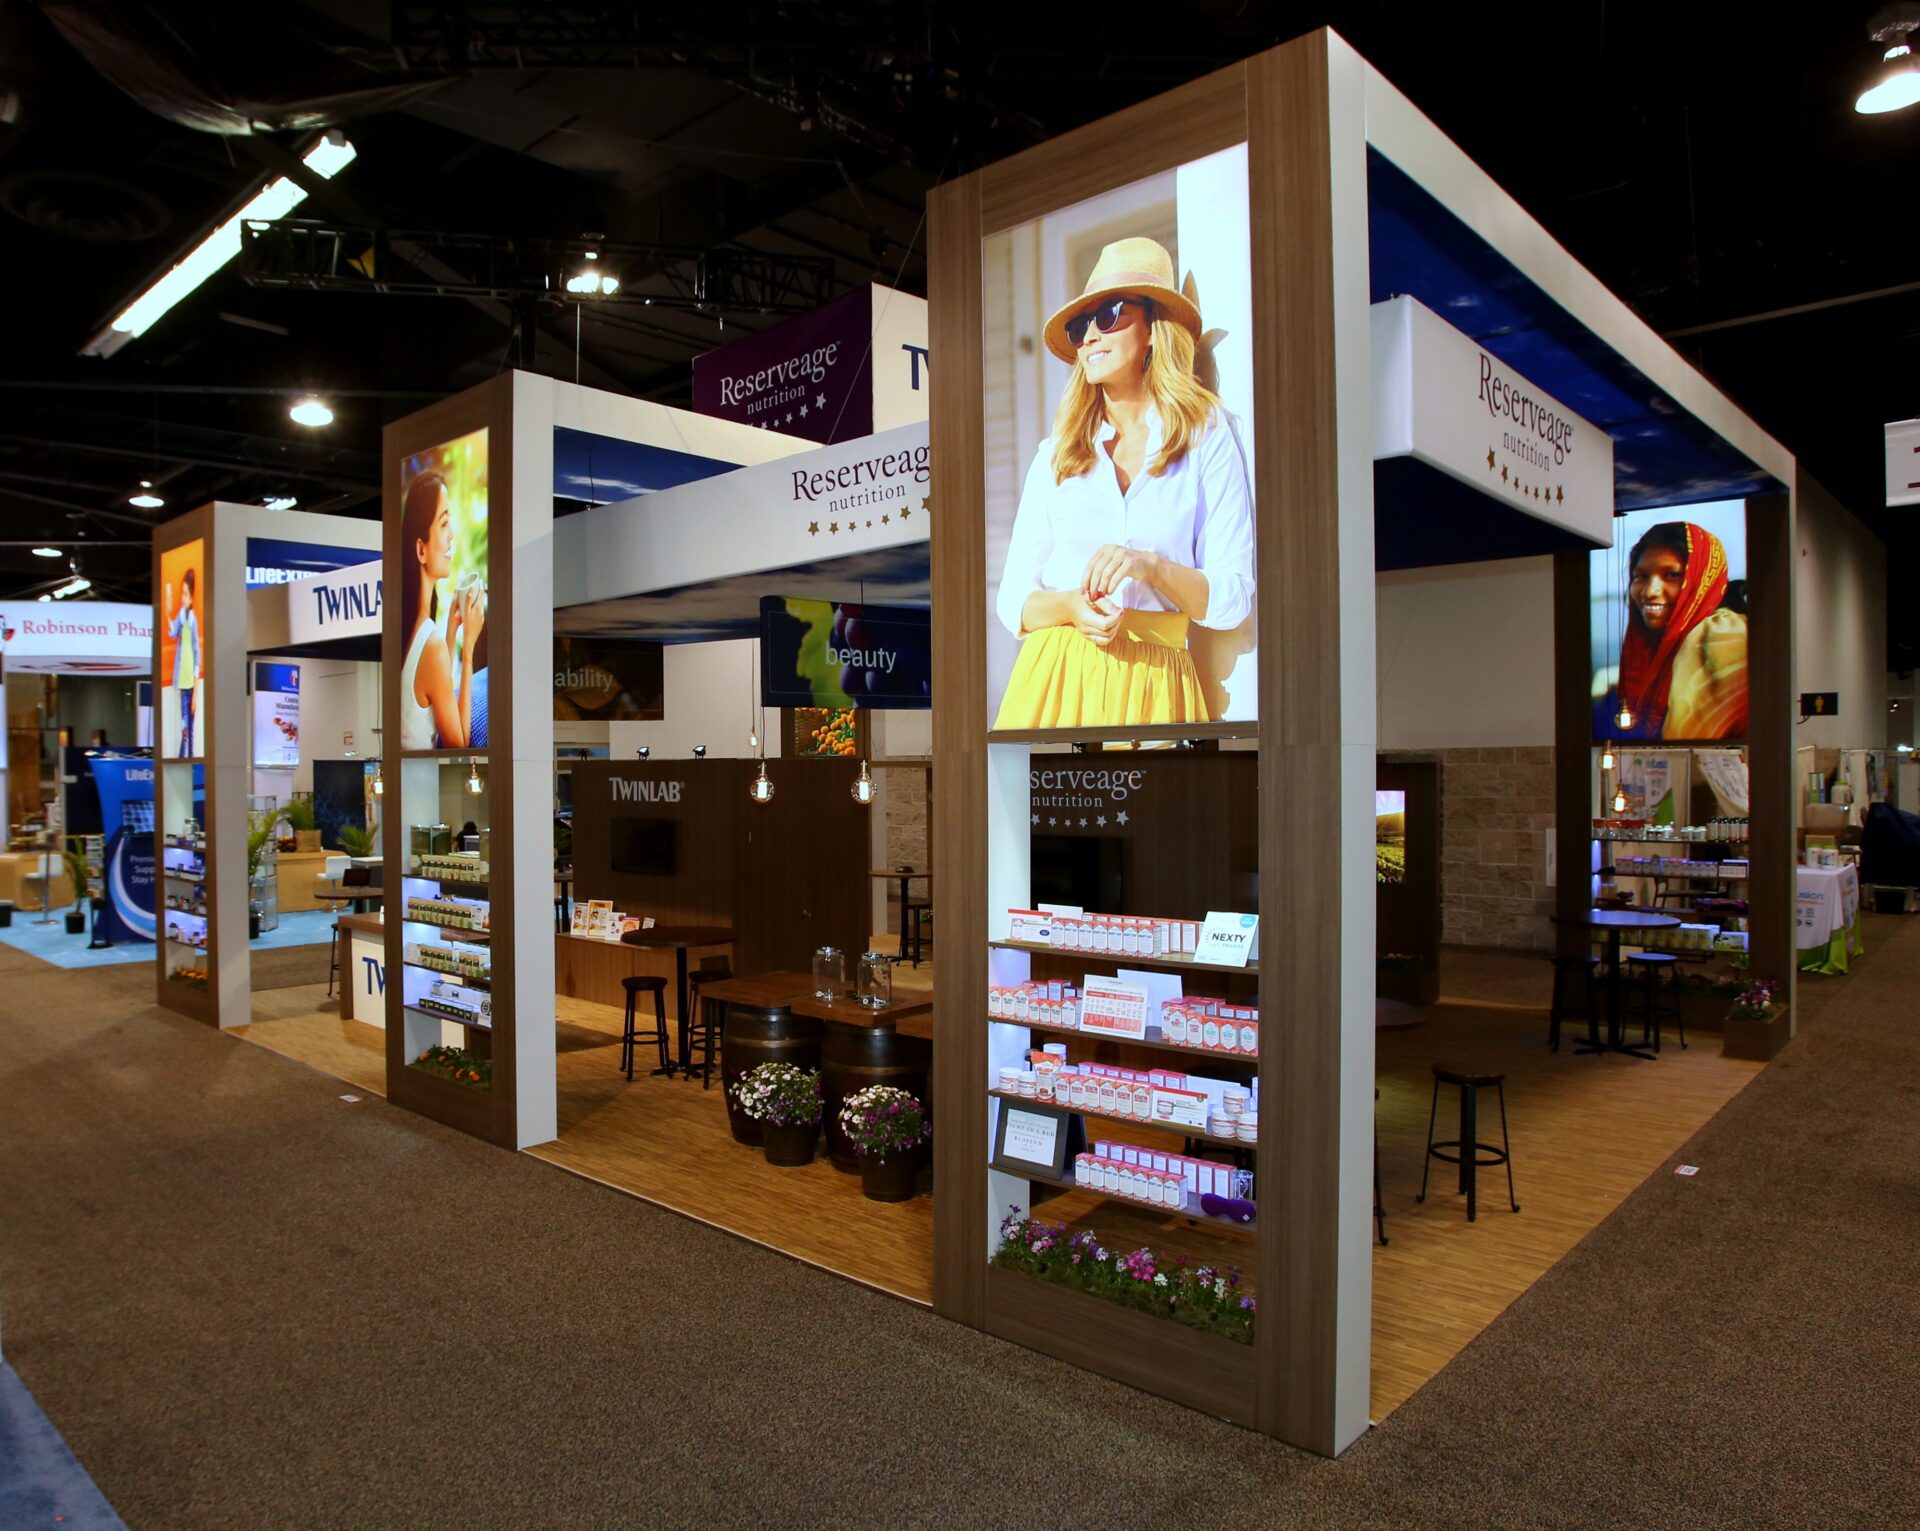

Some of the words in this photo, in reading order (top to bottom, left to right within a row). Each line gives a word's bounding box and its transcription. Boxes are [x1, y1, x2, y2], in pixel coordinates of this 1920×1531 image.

[720, 342, 838, 406] Reserveage
[747, 385, 805, 415] nutrition
[1478, 352, 1573, 465] Reserveage
[1503, 431, 1550, 471] nutrition
[829, 483, 906, 512] nutrition
[22, 619, 108, 636] Robinson
[825, 641, 897, 674] beauty
[554, 667, 614, 692] ability
[608, 776, 681, 803] TWINLAB
[1032, 793, 1104, 808] nutrition
[131, 875, 148, 885] Stay
[1212, 933, 1246, 943] NEXTY
